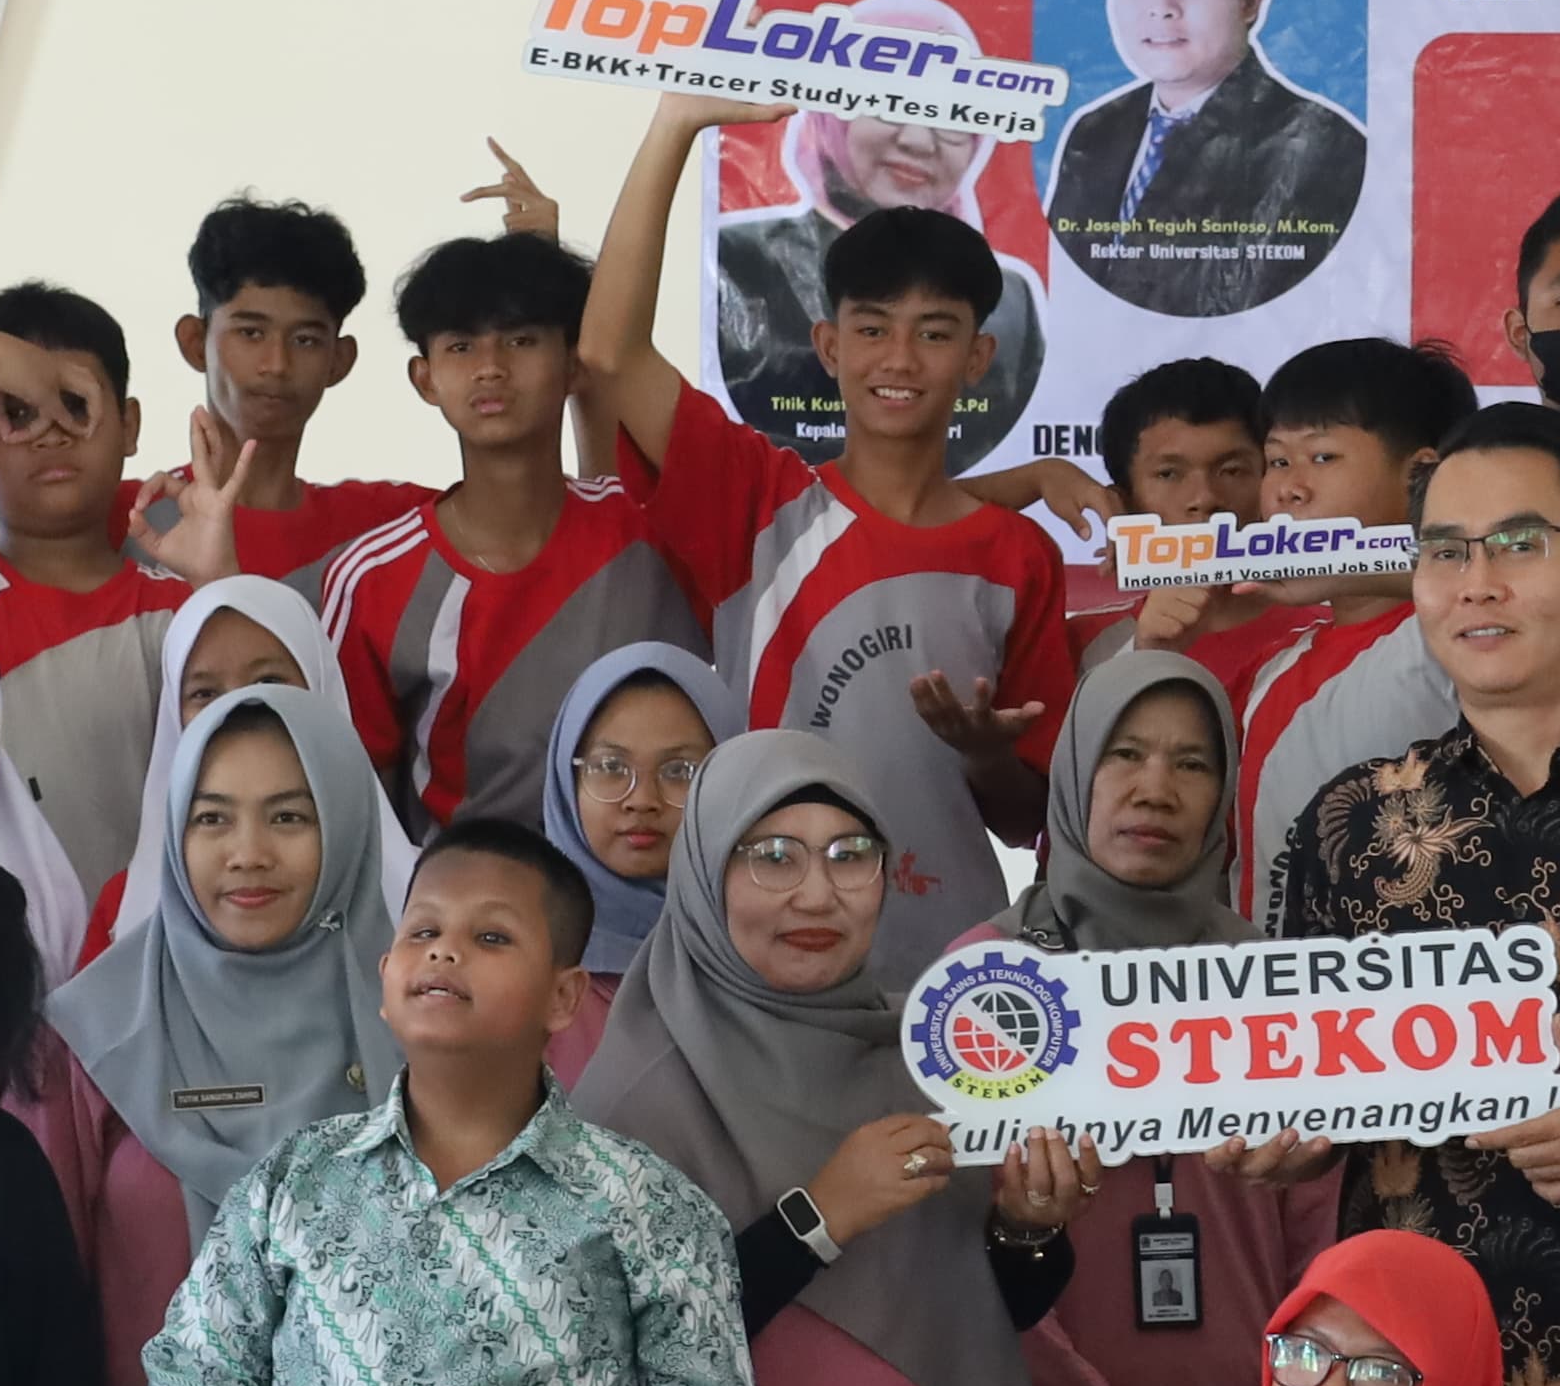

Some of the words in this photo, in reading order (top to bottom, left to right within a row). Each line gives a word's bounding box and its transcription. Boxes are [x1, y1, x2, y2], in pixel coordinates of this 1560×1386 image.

[950, 103, 1037, 134] Kerja
[1058, 219, 1080, 233] Dr.
[1086, 219, 1142, 235] Joseph
[1147, 219, 1196, 236] Teguh
[1202, 219, 1272, 235] Santoso,
[1277, 220, 1340, 234] M.Kom.
[1090, 243, 1143, 259] Rektor
[1150, 243, 1239, 259] Universitas
[1246, 244, 1305, 259] STEKOM
[771, 397, 805, 411] Titik
[1116, 524, 1411, 570] TopLoker.com
[1125, 572, 1209, 588] Indonesia
[1214, 570, 1234, 582] #1
[1240, 563, 1333, 581] Vocational
[1338, 561, 1369, 574] Job
[1374, 559, 1407, 572] Site
[810, 624, 912, 728] WONOGIRI
[1100, 937, 1545, 1006] UNIVERSITAS
[930, 1002, 953, 1074] UNIVERSITAS
[944, 975, 976, 1001] SAINS
[978, 971, 987, 981] &
[989, 969, 1053, 1005] TEKNOLOGI
[1041, 1003, 1062, 1067] KOMPUTER
[1105, 998, 1547, 1089] STEKOM
[952, 1073, 1044, 1099] STEKOM
